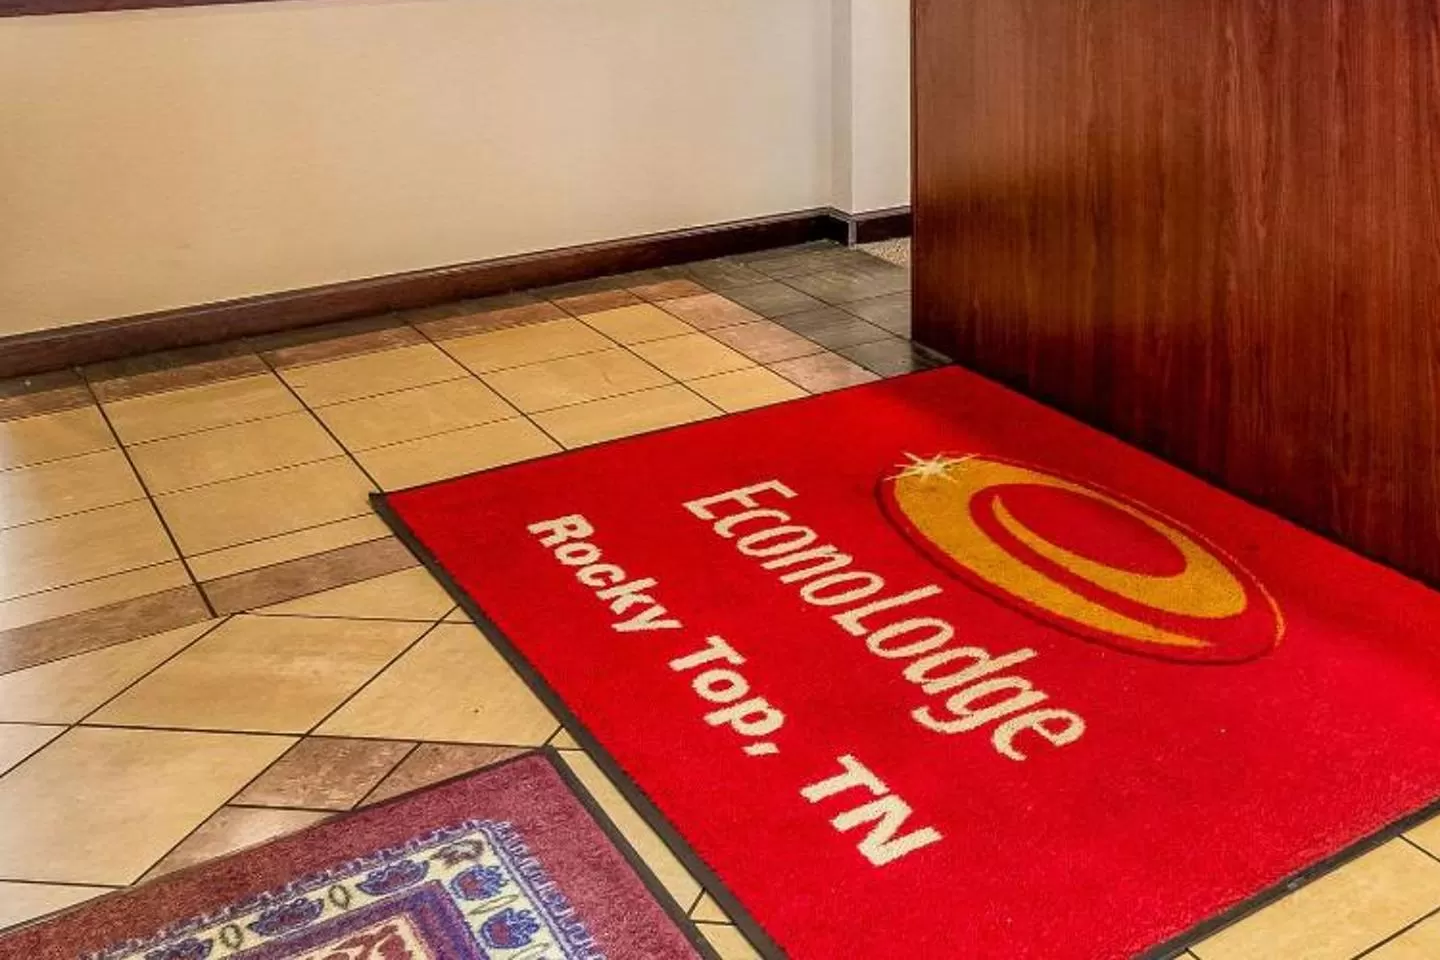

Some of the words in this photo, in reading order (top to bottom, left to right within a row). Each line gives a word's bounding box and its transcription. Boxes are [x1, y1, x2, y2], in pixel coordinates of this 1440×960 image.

[527, 512, 682, 634] Rocky
[669, 635, 787, 756] Top,
[800, 753, 942, 867] TN
